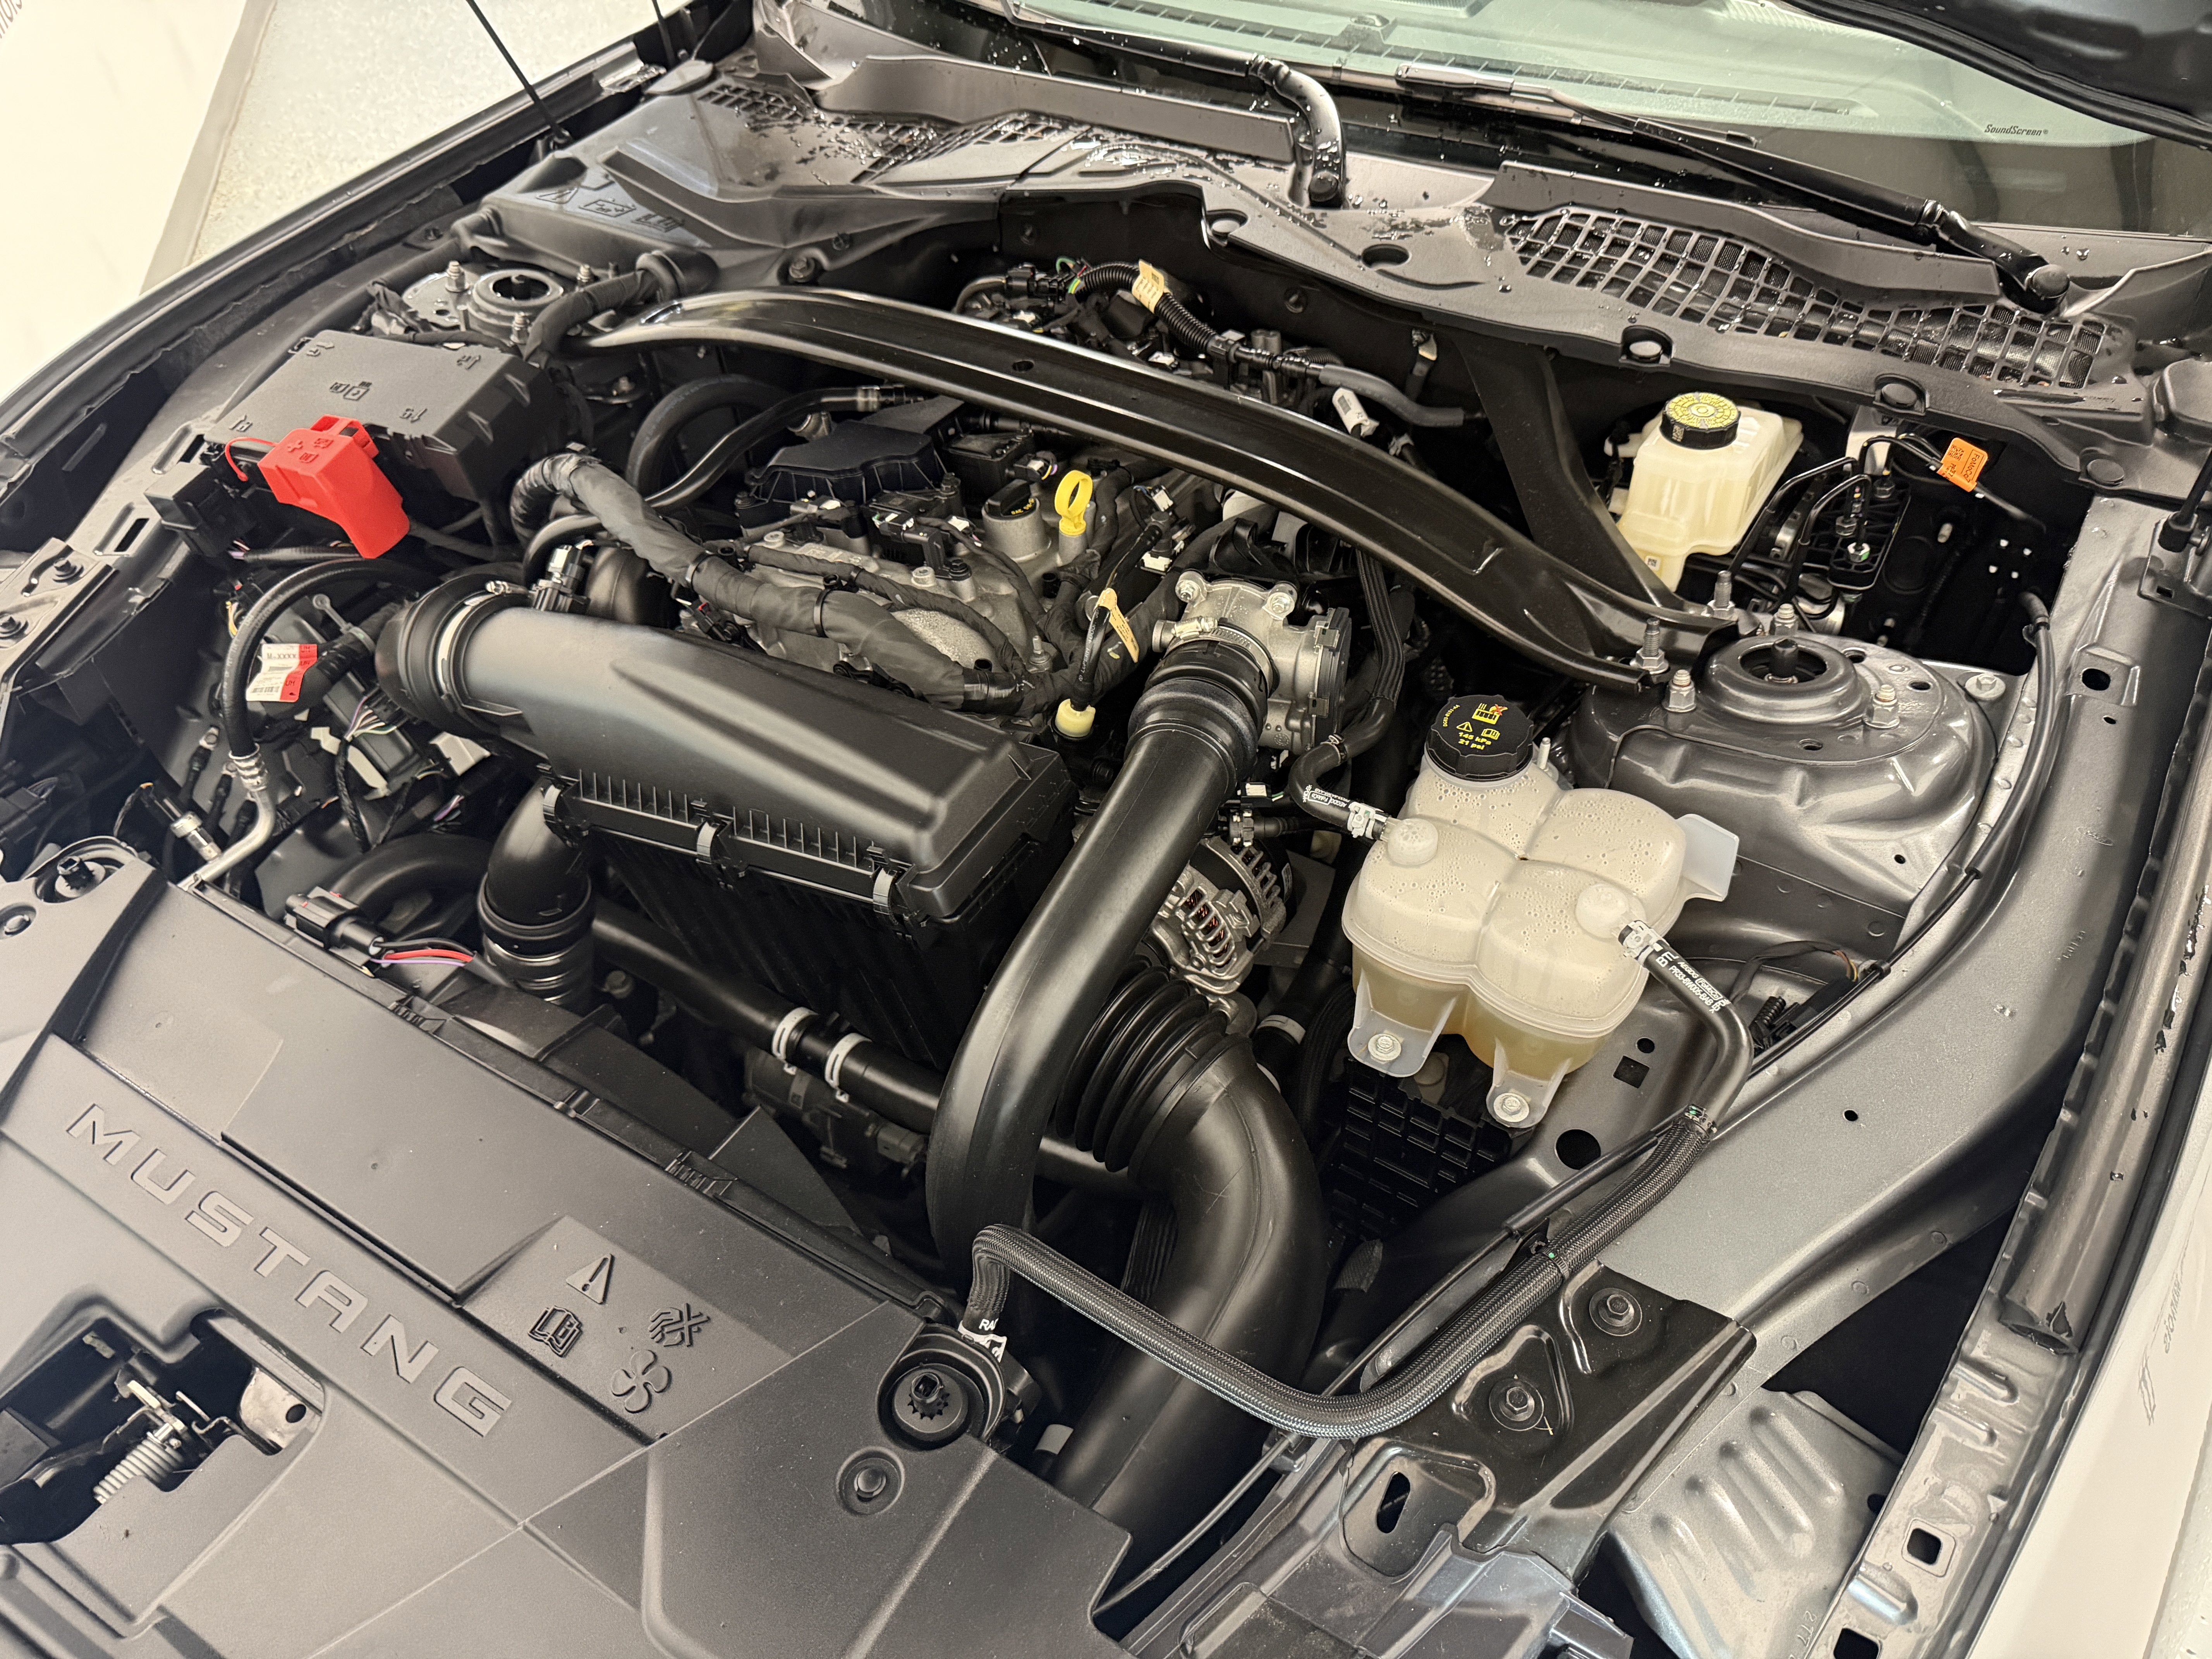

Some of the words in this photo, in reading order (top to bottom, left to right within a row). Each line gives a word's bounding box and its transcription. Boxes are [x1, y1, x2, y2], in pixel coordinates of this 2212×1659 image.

[1963, 453, 1980, 478] FoMoCo
[1475, 737, 1491, 745] kPa
[1698, 980, 1719, 998] FoMoCo
[66, 1103, 513, 1437] MUSTANG
